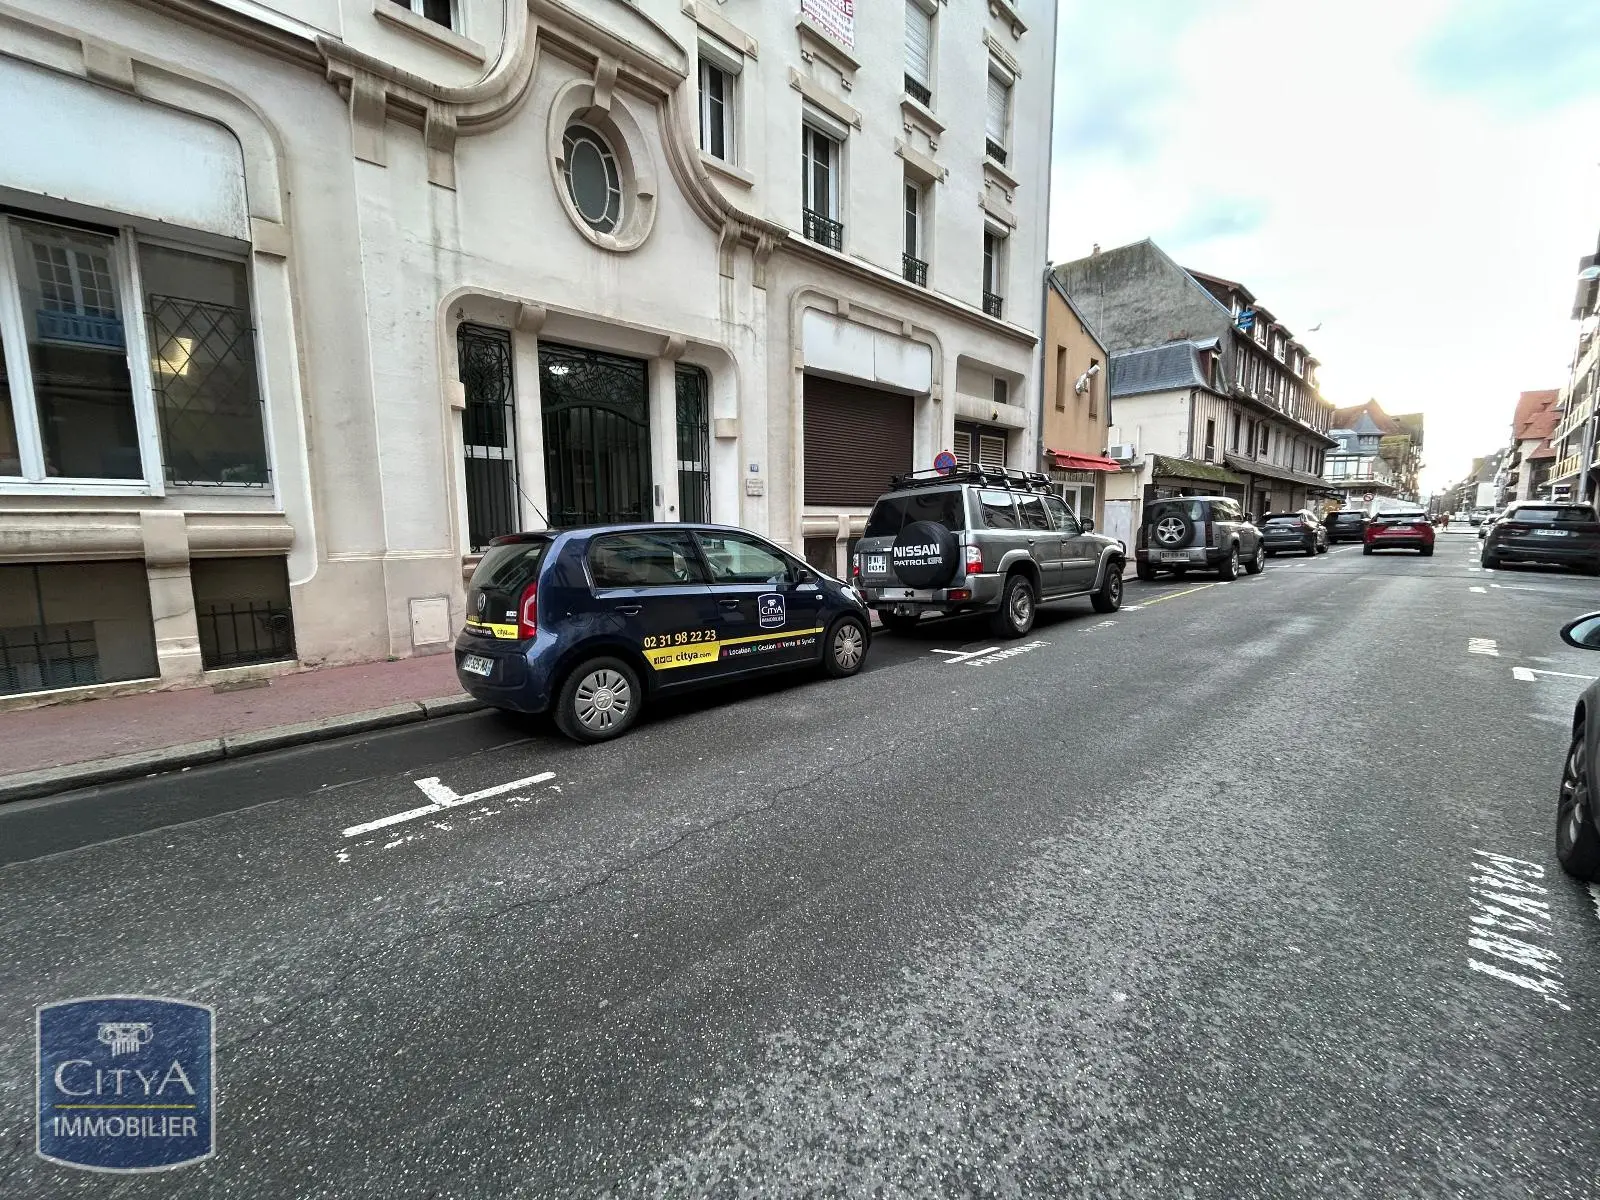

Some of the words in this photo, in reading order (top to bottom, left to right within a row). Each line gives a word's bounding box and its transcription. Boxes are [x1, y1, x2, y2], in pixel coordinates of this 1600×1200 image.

[893, 544, 940, 558] NISSAN
[644, 636, 657, 648] 02
[659, 634, 671, 647] 31
[675, 631, 688, 645] 98
[690, 631, 702, 642] 22
[704, 629, 717, 641] 23
[729, 646, 752, 656] Location
[758, 643, 777, 651] Gestion
[675, 651, 712, 662] citya.com
